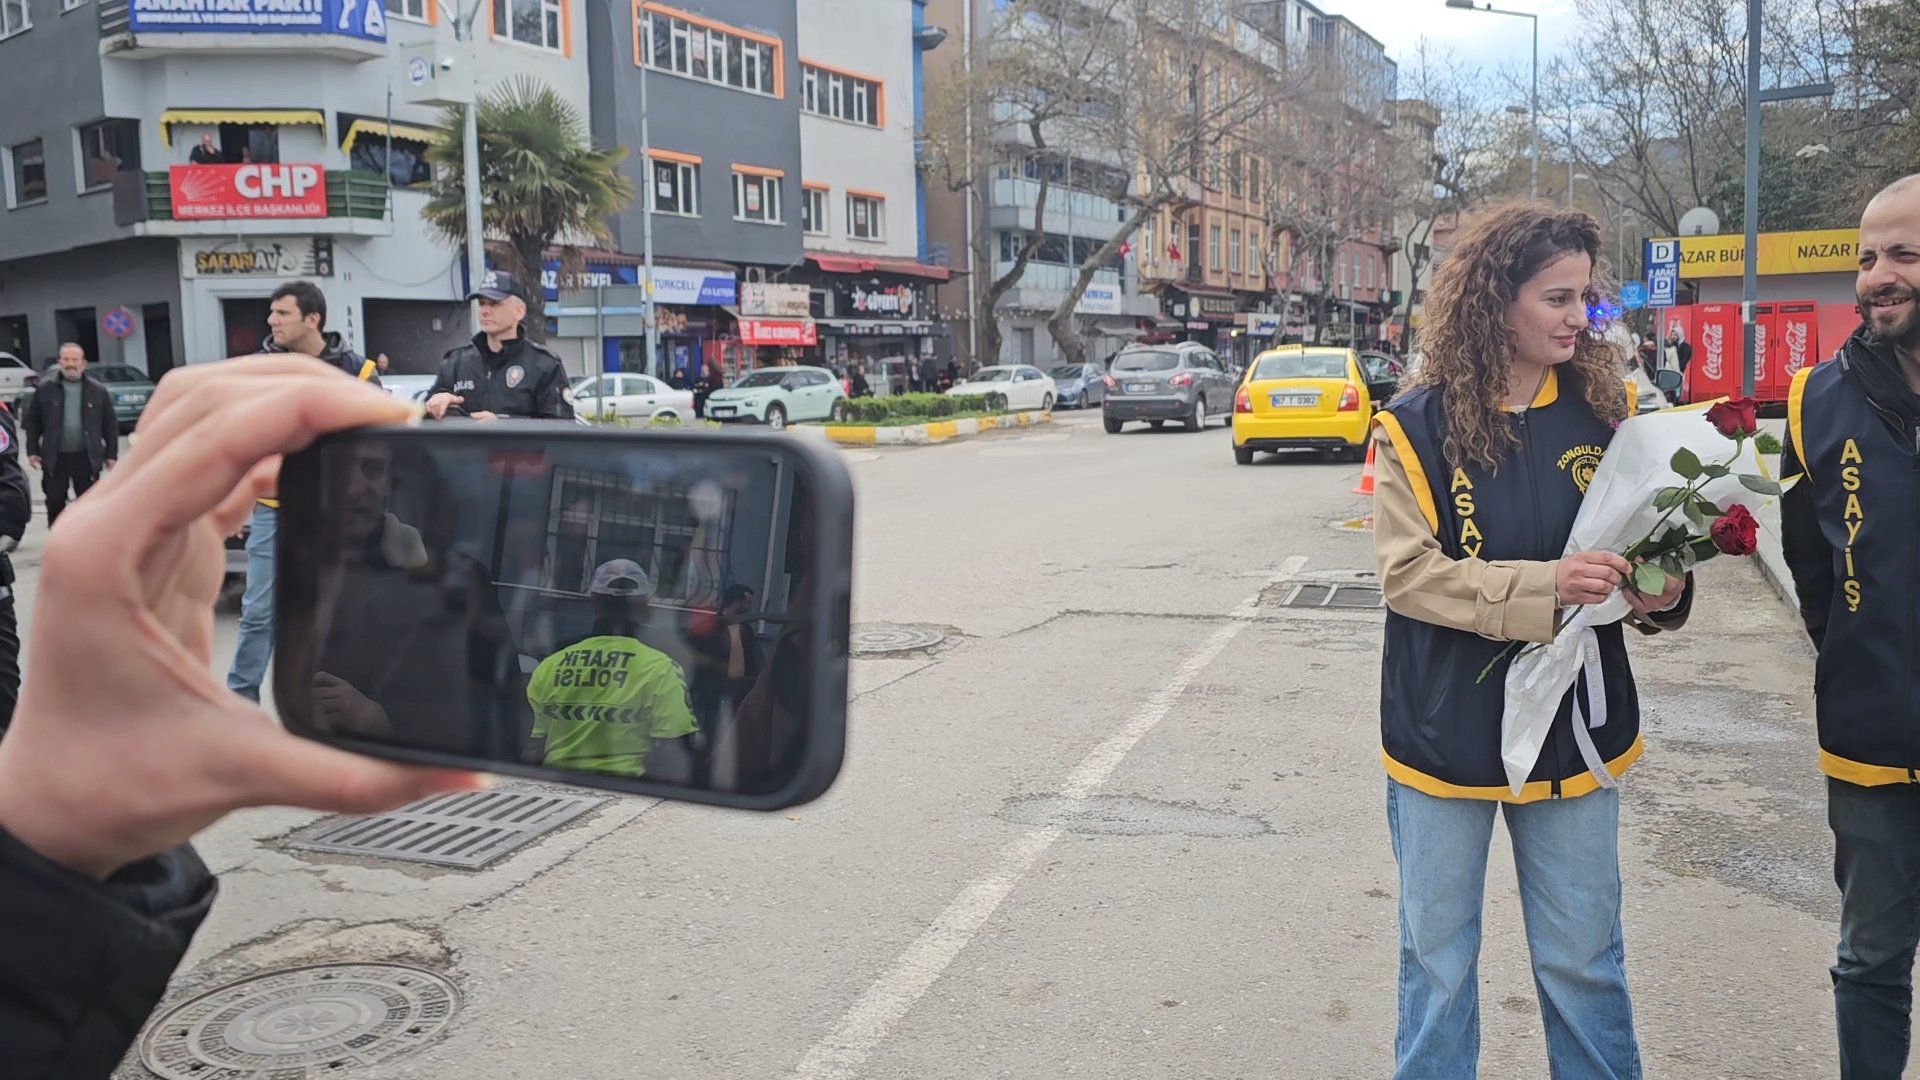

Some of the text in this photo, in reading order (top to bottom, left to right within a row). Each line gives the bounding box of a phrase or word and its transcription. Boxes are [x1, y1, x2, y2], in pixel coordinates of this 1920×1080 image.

[234, 164, 318, 199] CHP
[1656, 245, 1669, 260] D
[1797, 243, 1850, 259] NAZAR
[654, 278, 696, 292] TURKCELL
[1657, 280, 1669, 290] D
[1839, 438, 1864, 613] ASAYİŞ
